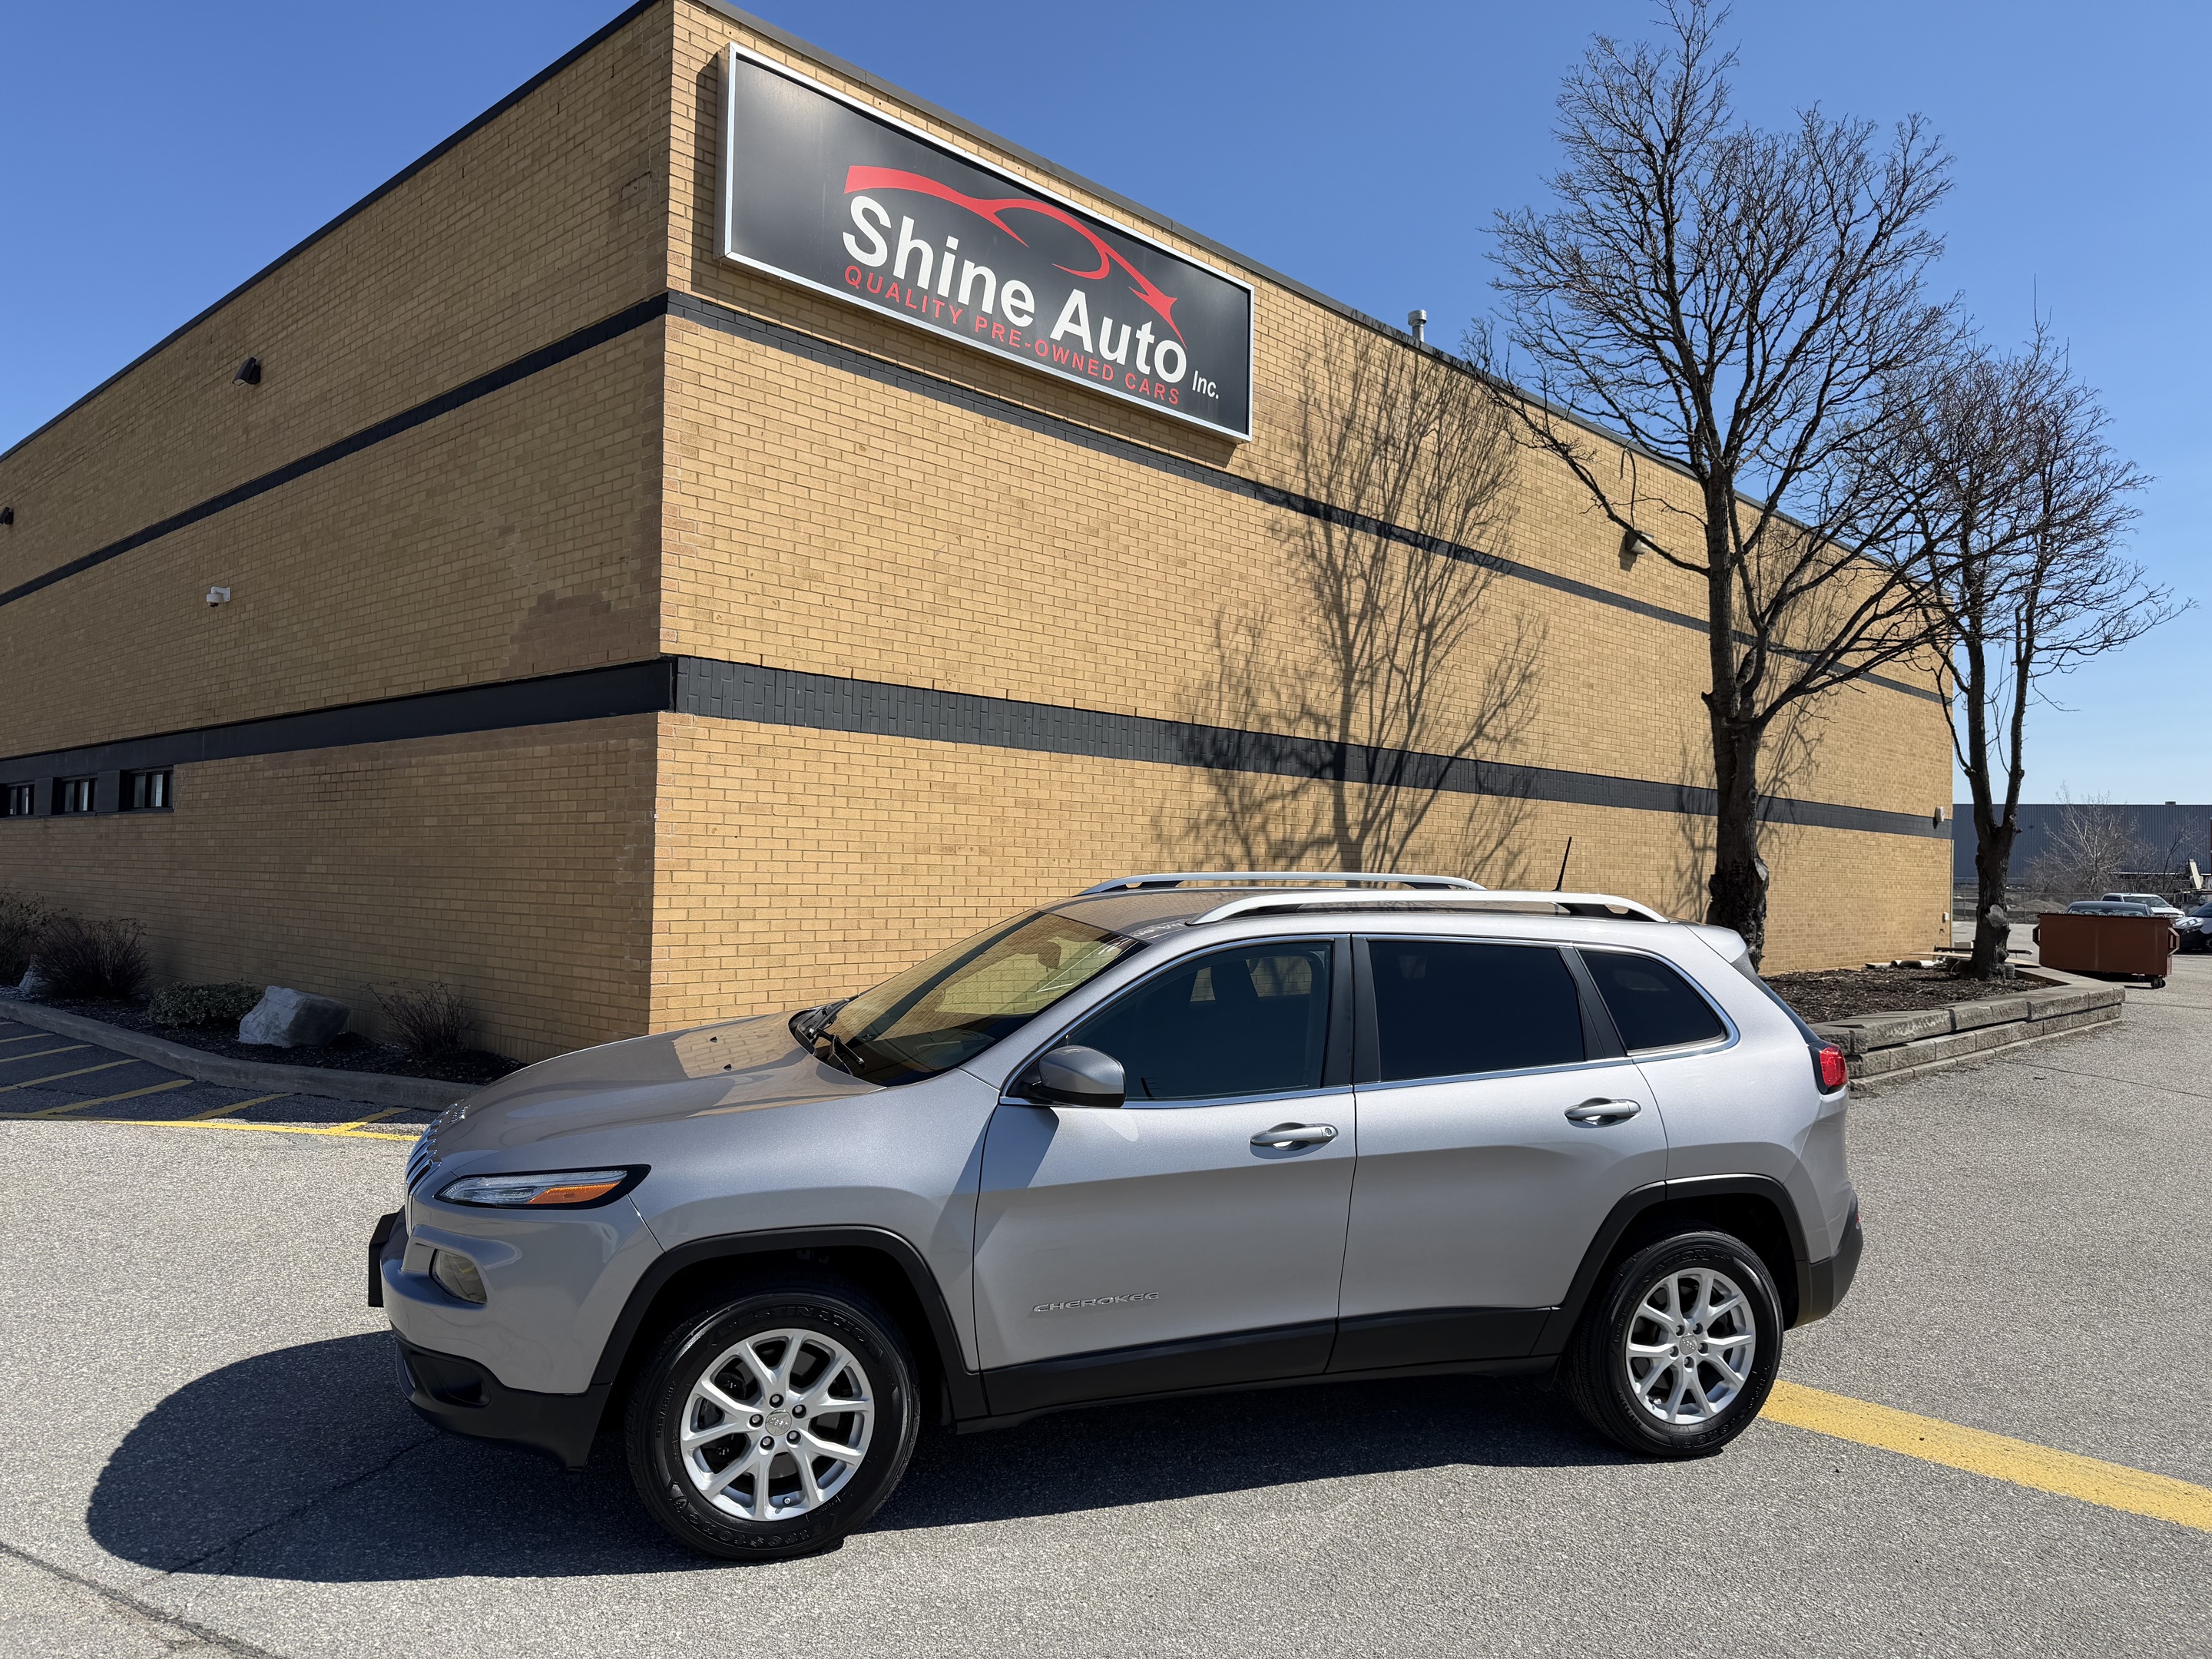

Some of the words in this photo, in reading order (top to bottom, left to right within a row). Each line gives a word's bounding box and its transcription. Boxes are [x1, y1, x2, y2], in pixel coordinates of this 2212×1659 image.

[843, 194, 1035, 327] Shine
[1049, 289, 1187, 383] Auto
[1192, 370, 1220, 399] Inc.
[845, 266, 964, 324] QUALITY
[975, 316, 1114, 381] PRE-OWNED
[1124, 373, 1180, 405] CARS
[1033, 1291, 1159, 1312] CHEROKEE
